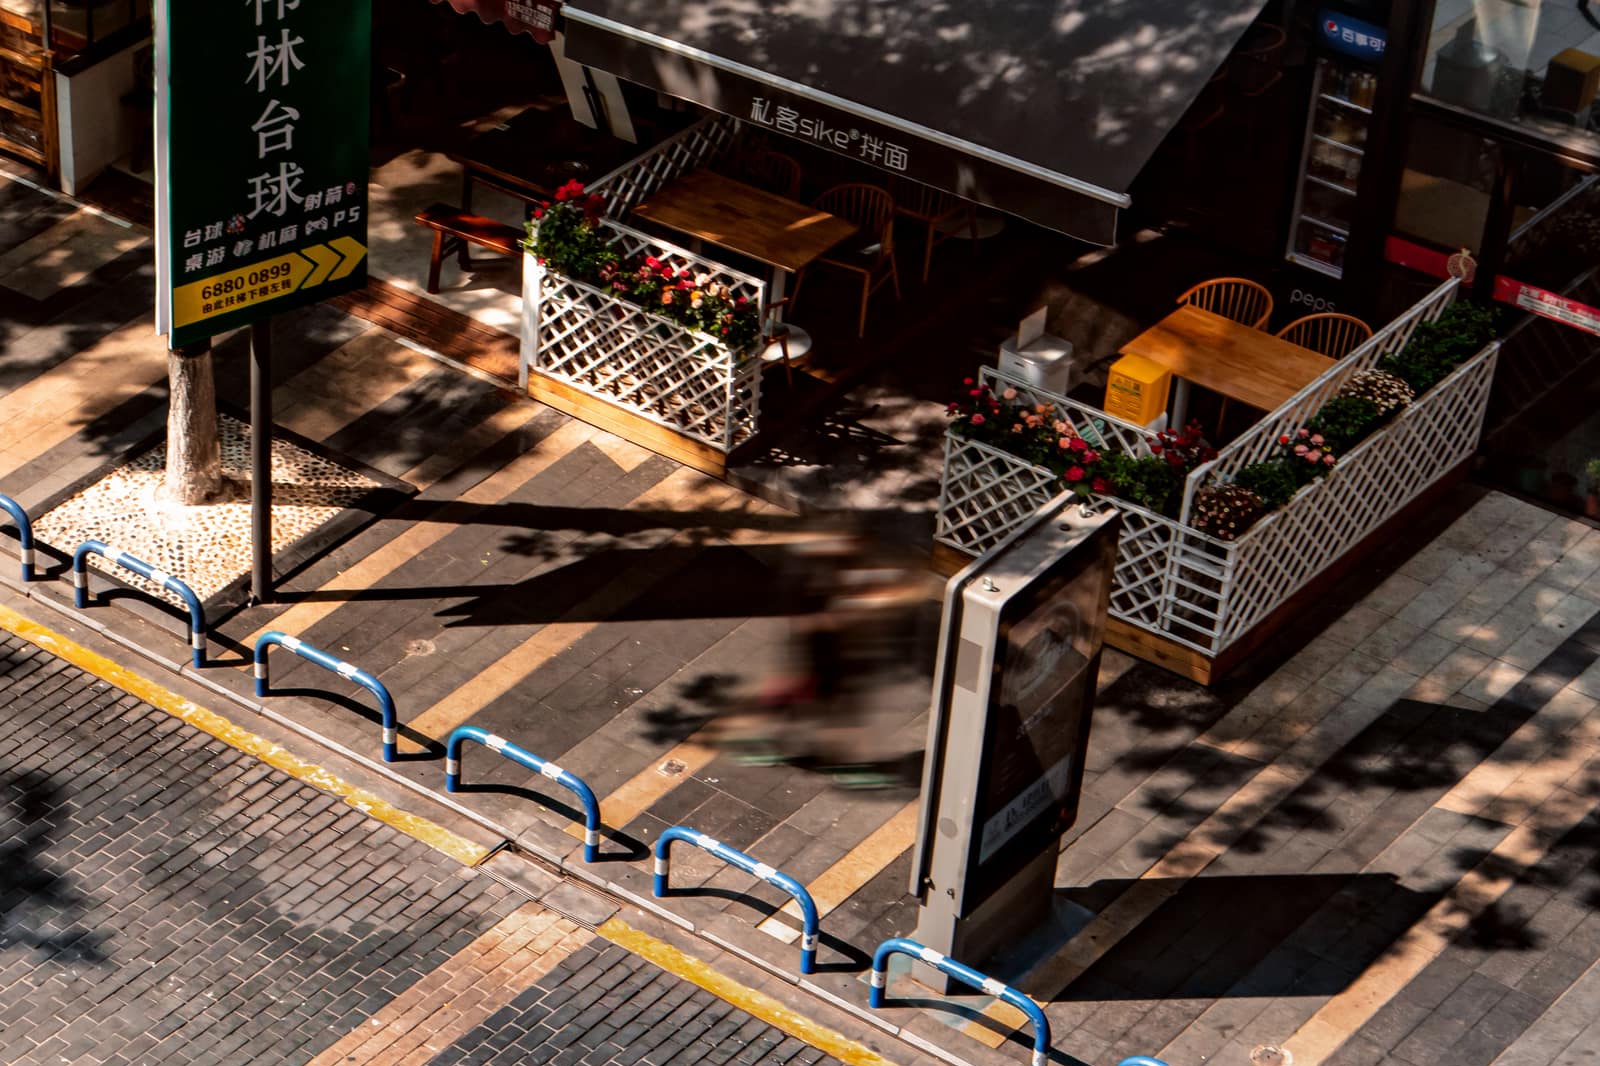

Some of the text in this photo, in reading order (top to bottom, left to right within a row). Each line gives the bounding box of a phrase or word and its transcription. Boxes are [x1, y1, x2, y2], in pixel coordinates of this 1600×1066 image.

[183, 221, 224, 248] 台球
[184, 246, 226, 273] 桌游
[202, 262, 291, 300] 6880 0899
[1289, 288, 1338, 313] peps
